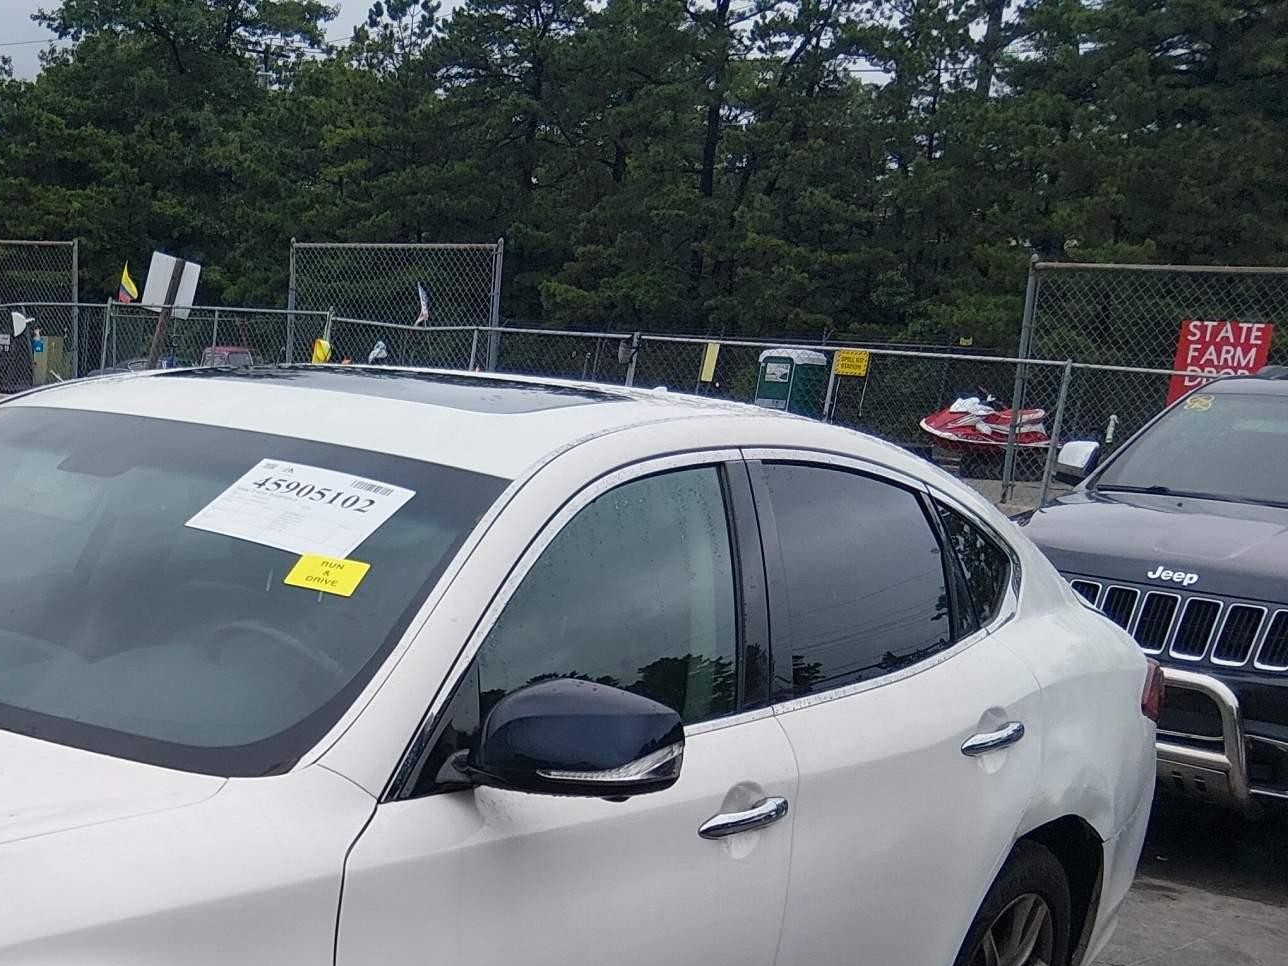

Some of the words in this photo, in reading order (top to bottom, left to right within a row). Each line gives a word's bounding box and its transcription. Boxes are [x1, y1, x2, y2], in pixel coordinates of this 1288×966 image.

[1187, 321, 1265, 345] STATE
[1186, 344, 1257, 368] FARM
[253, 476, 376, 513] 45905102
[320, 560, 345, 570] RUN
[1147, 565, 1199, 587] Jeep
[305, 575, 339, 587] DRIVE
